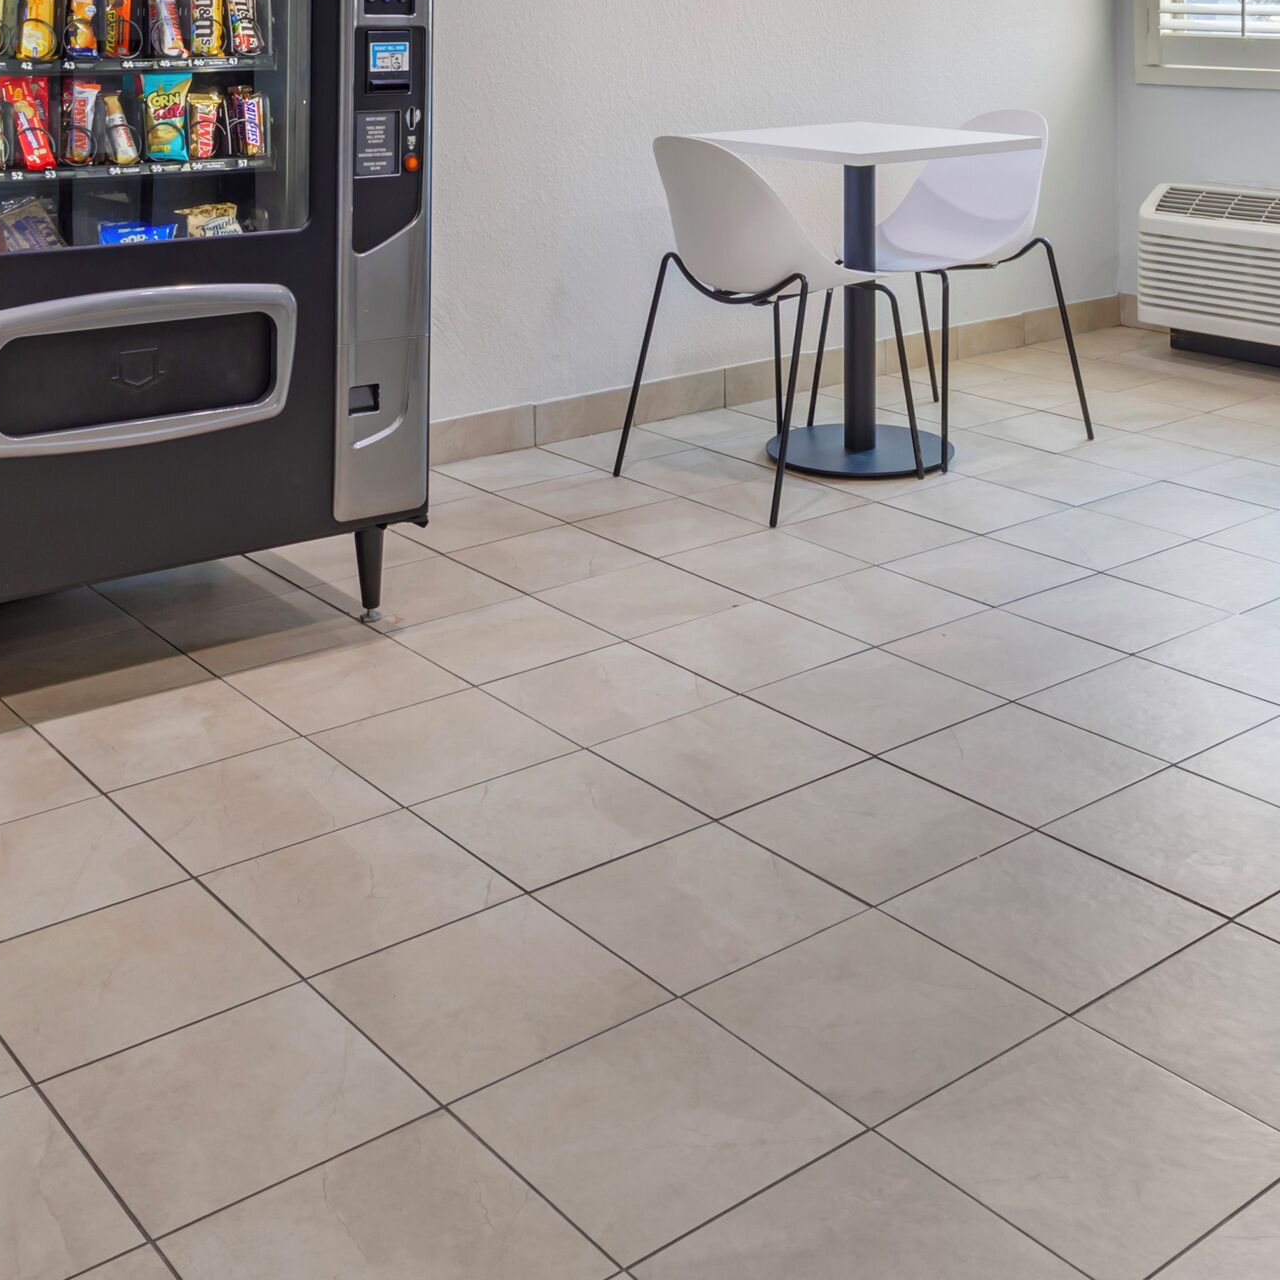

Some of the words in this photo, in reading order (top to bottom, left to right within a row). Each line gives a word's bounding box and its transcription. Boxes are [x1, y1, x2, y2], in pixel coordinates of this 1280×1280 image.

[21, 62, 32, 70] 42
[64, 62, 75, 70] 43
[147, 90, 181, 109] CORN
[197, 110, 217, 158] TWIX
[45, 171, 56, 179] 53
